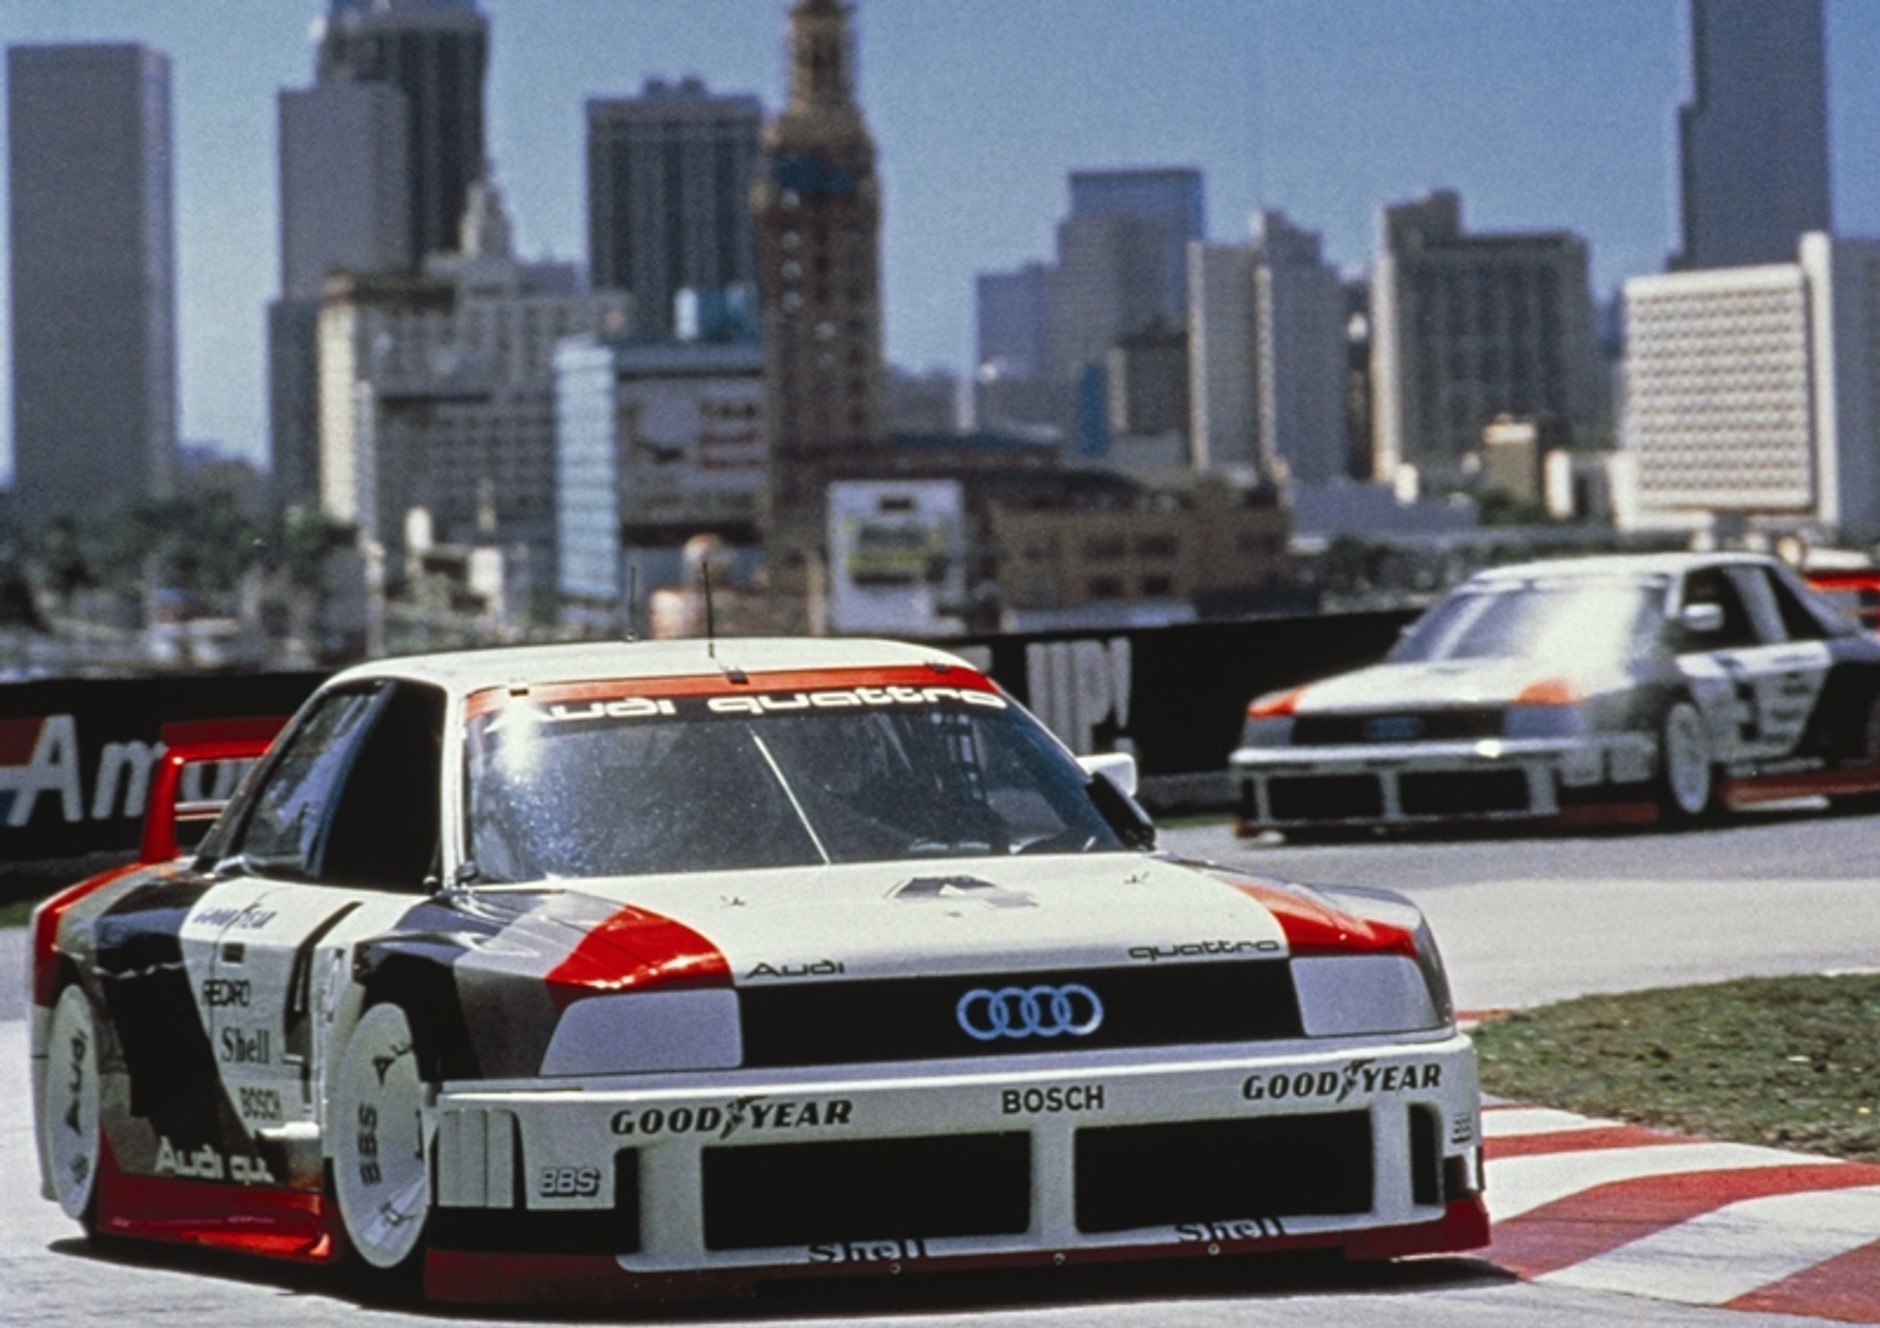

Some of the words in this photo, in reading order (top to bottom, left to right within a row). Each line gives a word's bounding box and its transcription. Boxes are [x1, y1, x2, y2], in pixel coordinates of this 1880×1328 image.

[708, 684, 1008, 715] quattro
[1128, 939, 1280, 960] quattro
[745, 960, 845, 979] Audi
[222, 1026, 269, 1065] Shell
[1001, 1085, 1105, 1115] BOSCH
[154, 1135, 225, 1179] Audi
[357, 1102, 382, 1187] BBS
[540, 1166, 601, 1198] BBS
